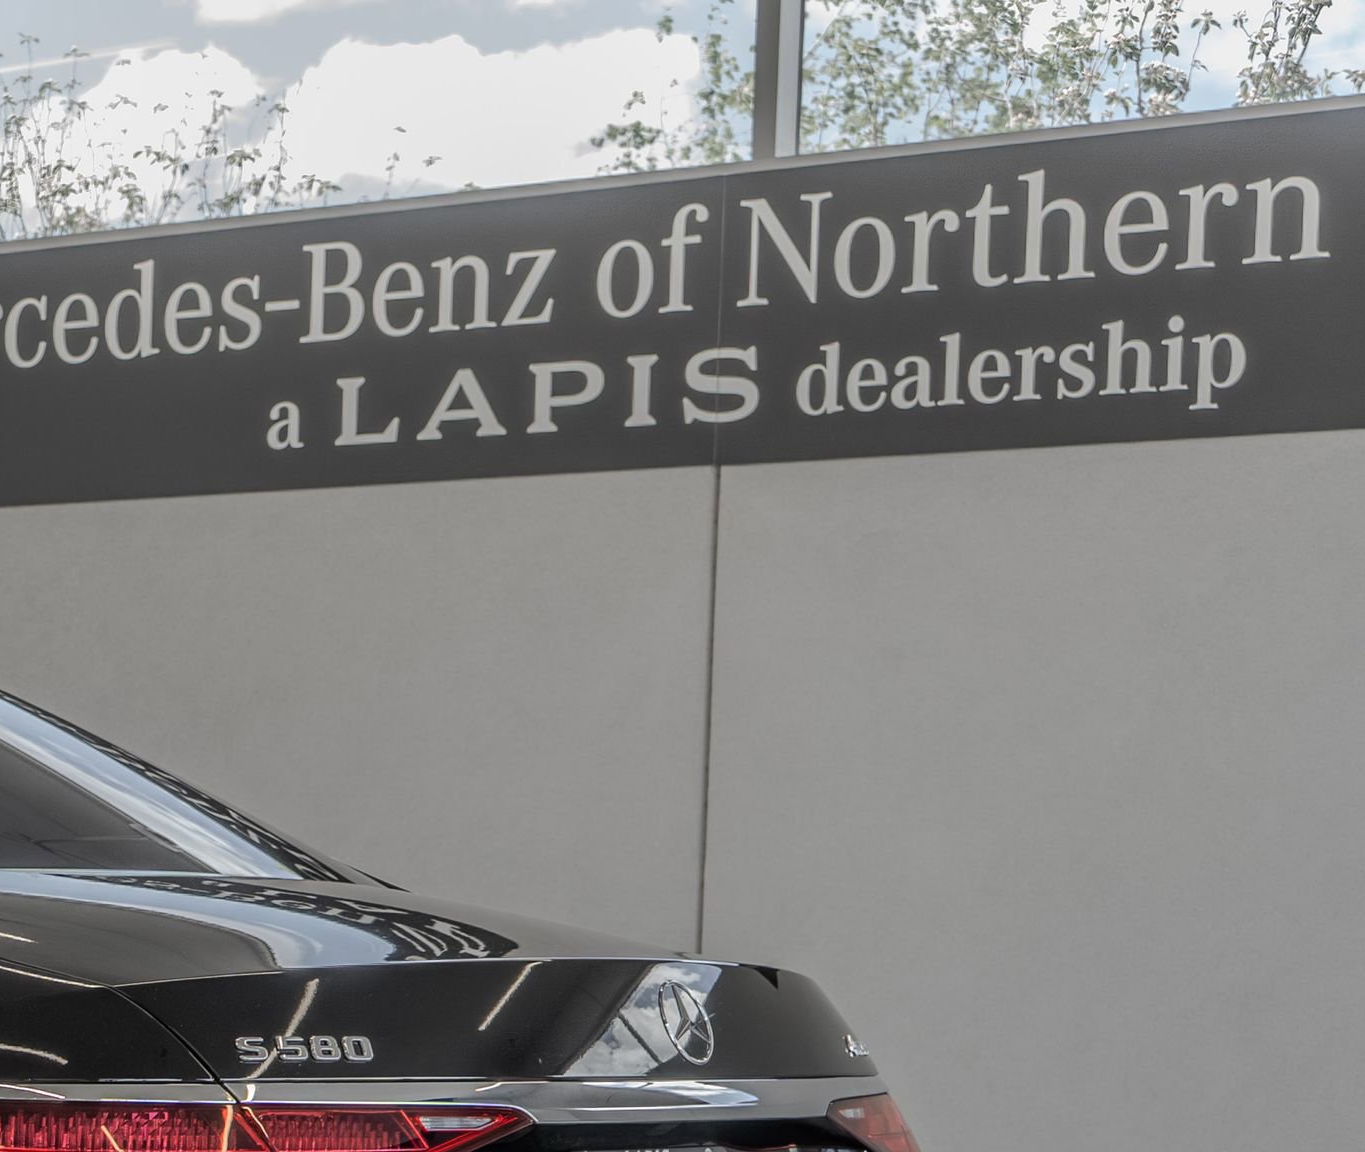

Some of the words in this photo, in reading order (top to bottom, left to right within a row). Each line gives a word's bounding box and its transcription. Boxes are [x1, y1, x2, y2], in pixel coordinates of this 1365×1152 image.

[595, 201, 711, 320] of
[735, 167, 1332, 309] Northern
[265, 400, 306, 451] a
[333, 344, 761, 447] LAPIS
[794, 314, 1248, 416] dealership
